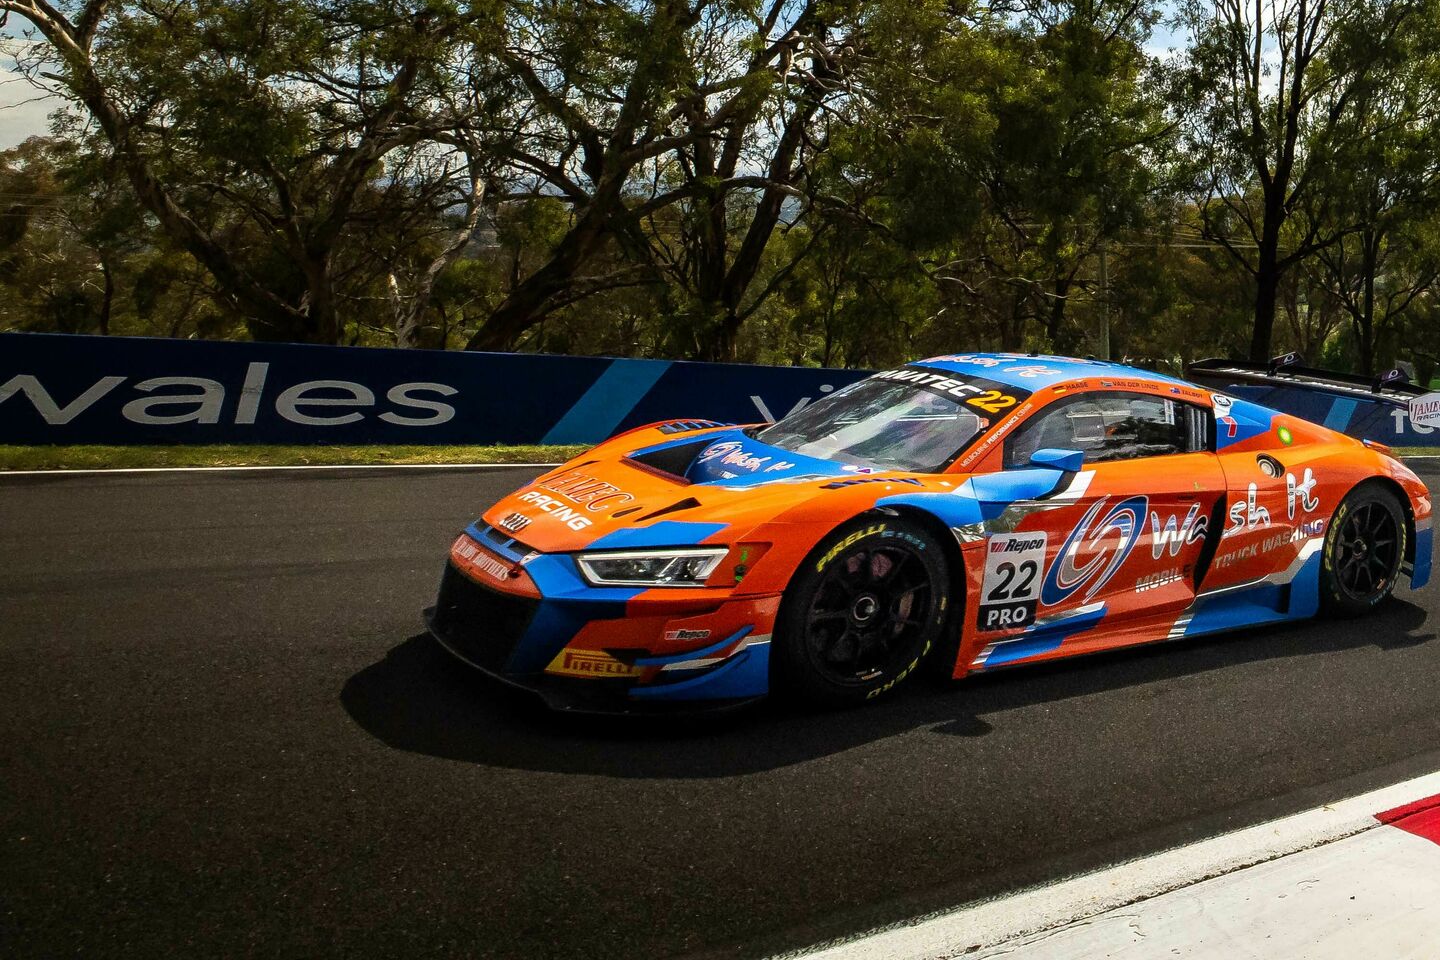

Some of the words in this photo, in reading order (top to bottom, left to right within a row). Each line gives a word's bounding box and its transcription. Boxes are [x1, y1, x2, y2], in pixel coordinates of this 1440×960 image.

[965, 390, 1017, 414] 22
[960, 442, 989, 468] MELBOURNE
[987, 414, 1020, 444] PERFORMANCE
[519, 490, 593, 531] RACING
[1006, 538, 1045, 554] Repco
[1215, 543, 1257, 569] TRUCK
[1262, 519, 1324, 553] WASHING
[987, 559, 1038, 602] 22
[1135, 565, 1192, 594] MOBILE
[987, 606, 1028, 626] PRO
[676, 628, 711, 640] Repco
